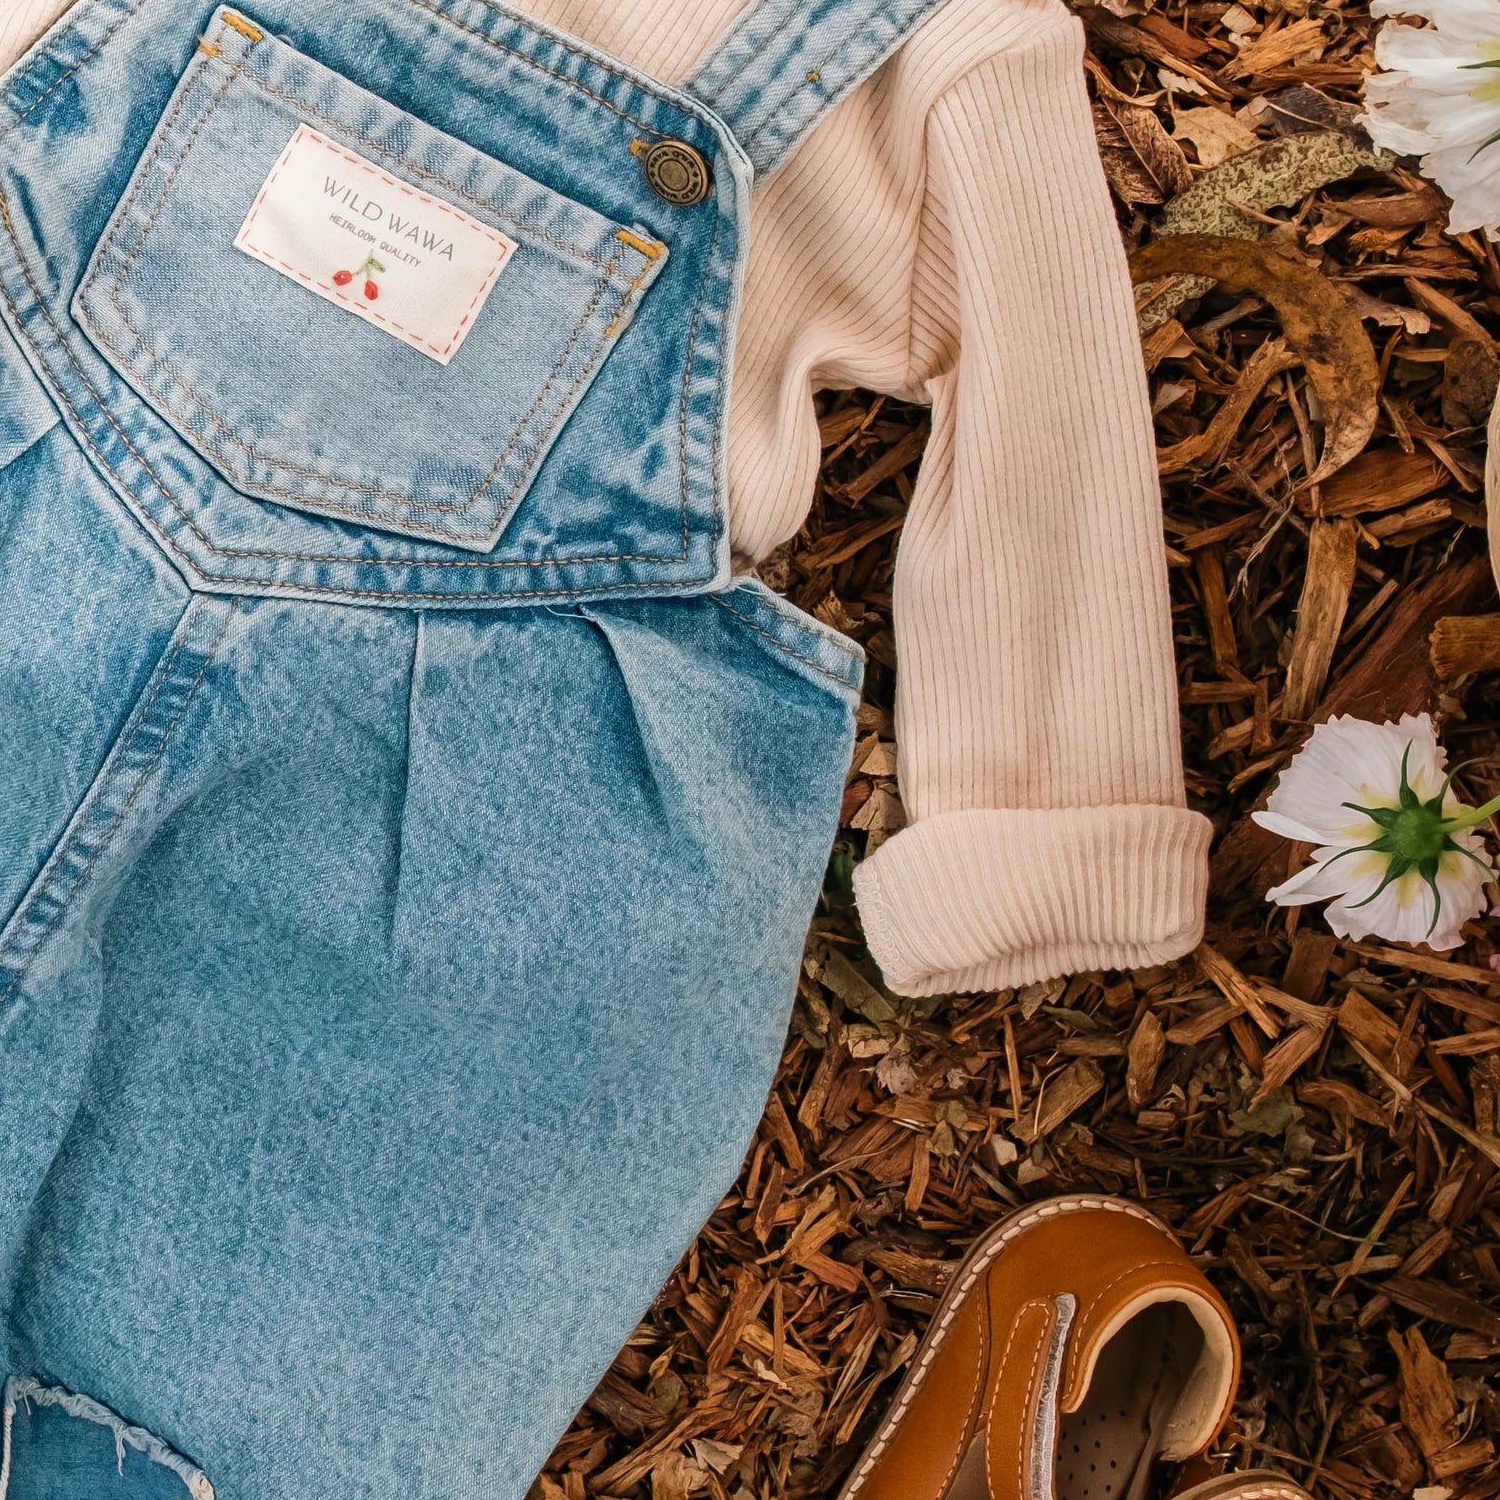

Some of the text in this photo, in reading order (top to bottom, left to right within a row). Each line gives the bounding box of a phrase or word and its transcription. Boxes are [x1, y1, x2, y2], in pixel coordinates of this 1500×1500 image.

[323, 176, 455, 262] WILD WAWA
[329, 212, 422, 268] HEIRLOOM QUALITY
